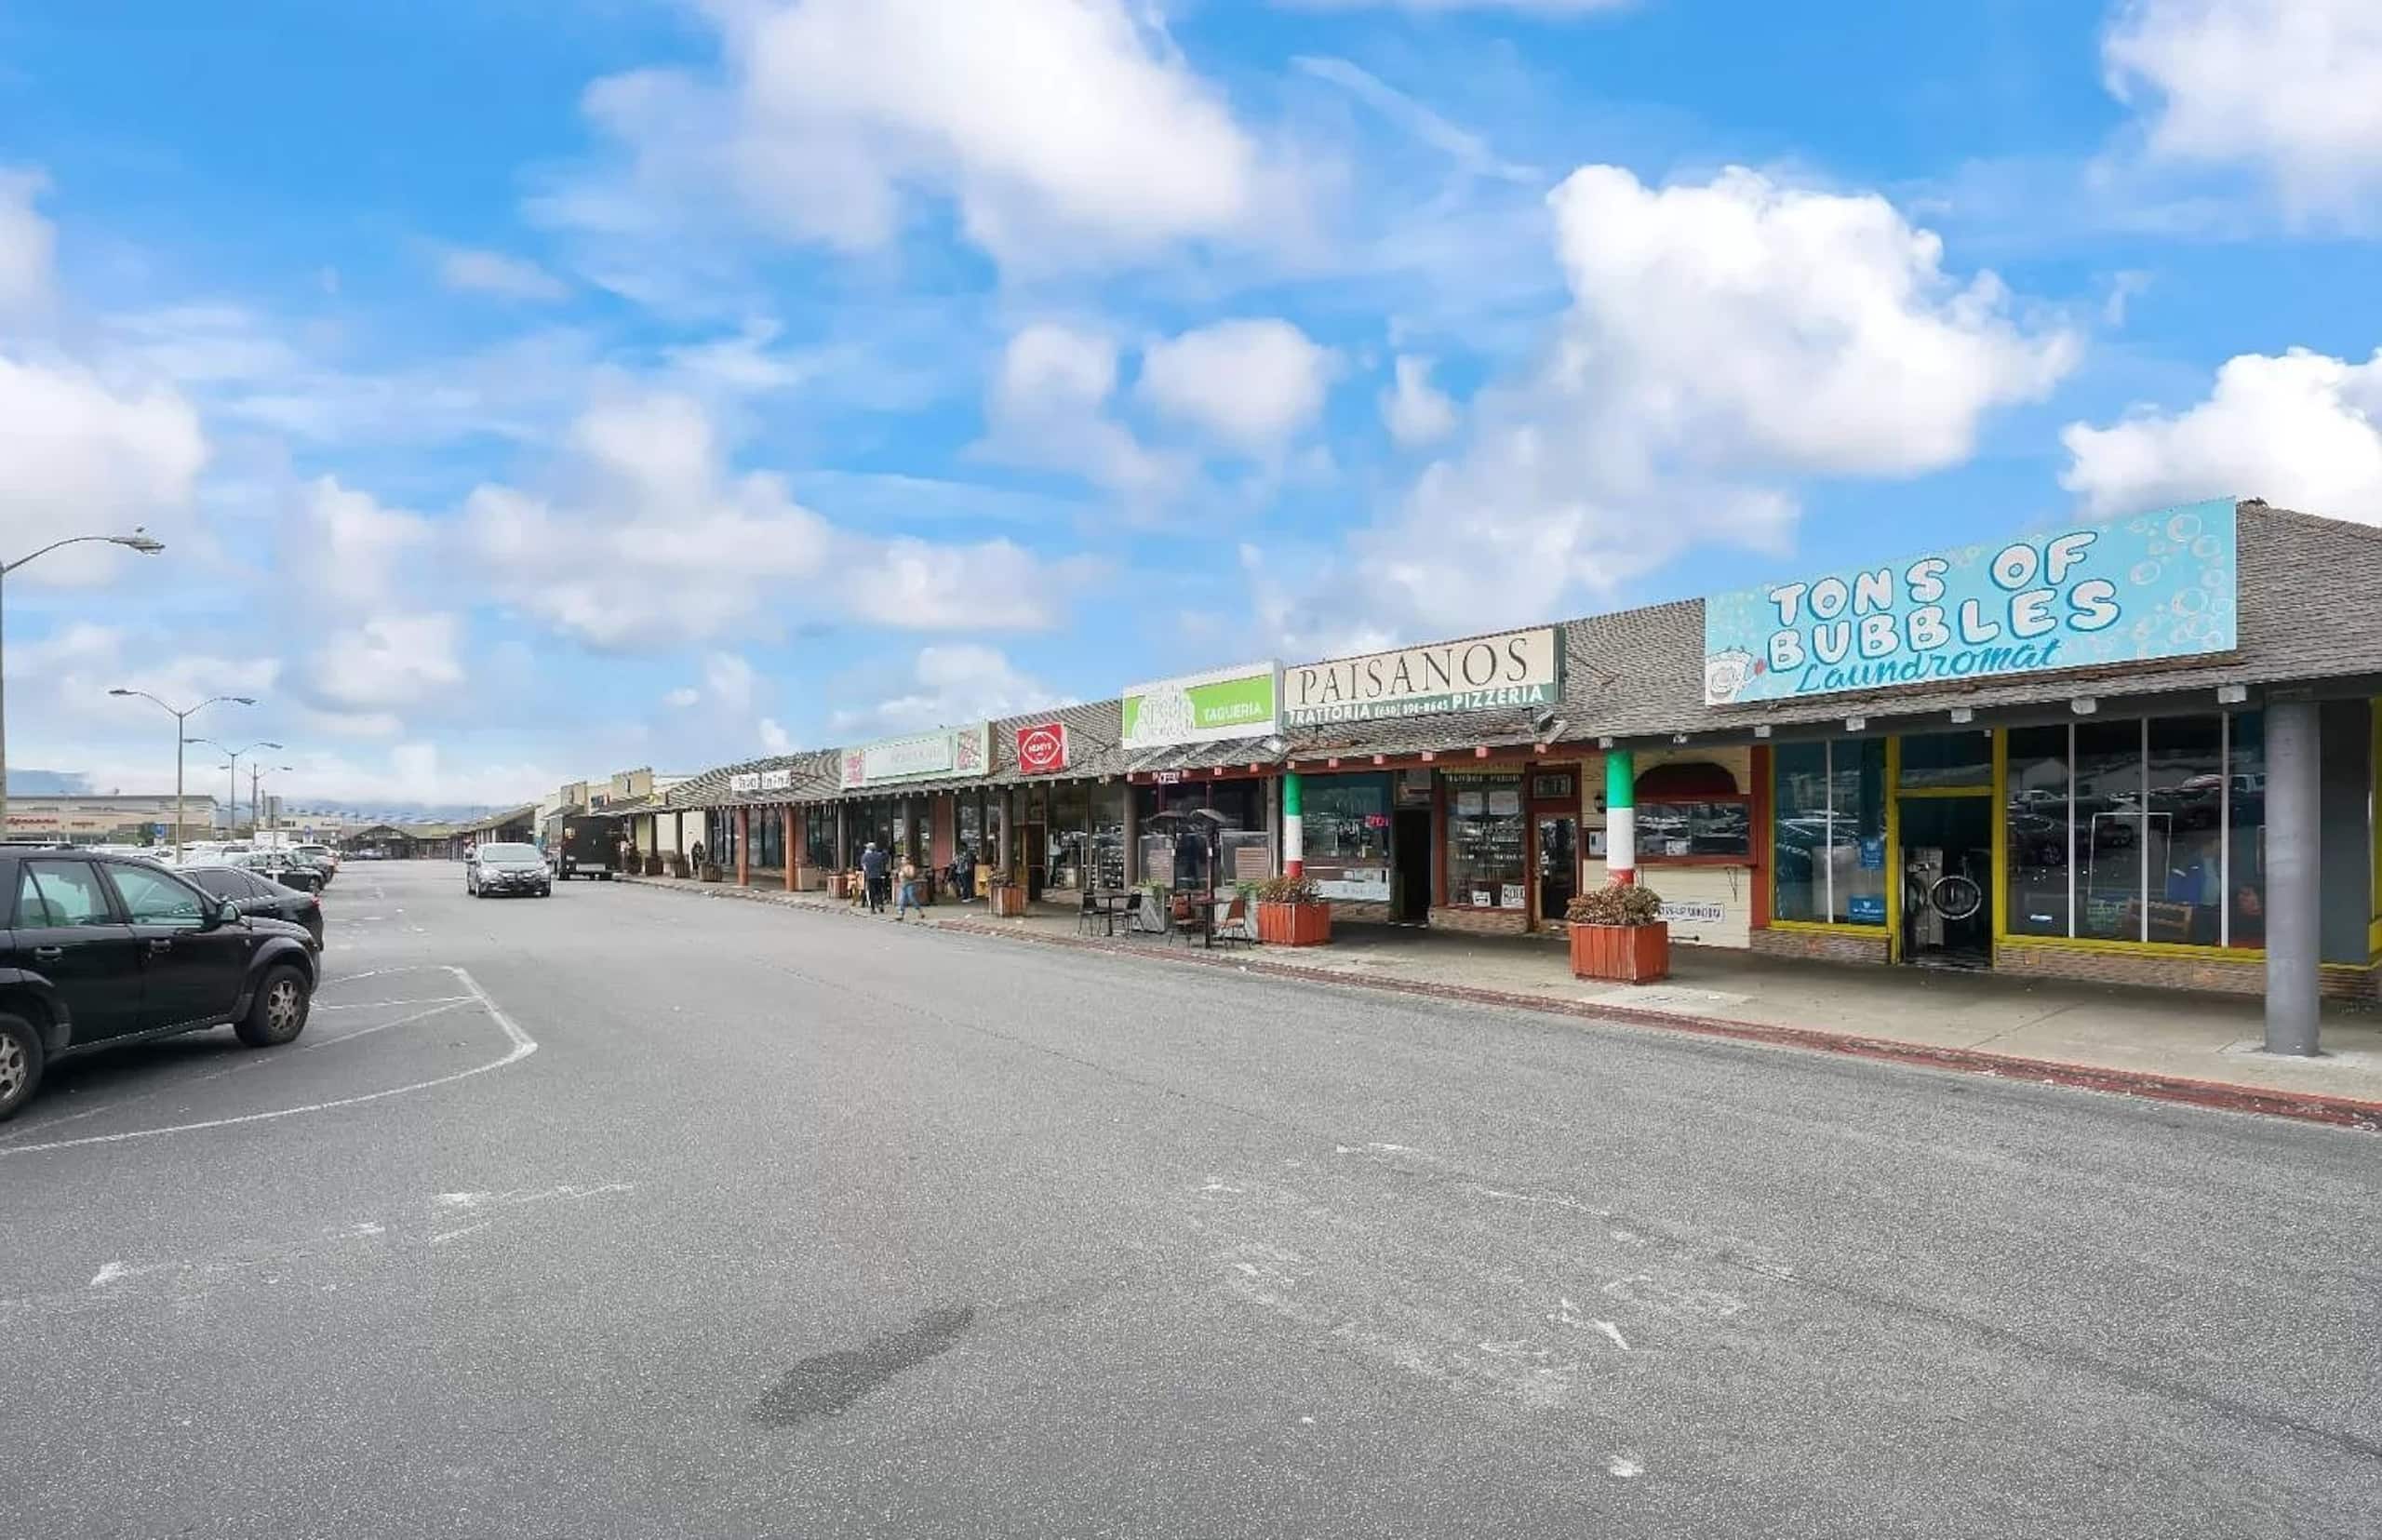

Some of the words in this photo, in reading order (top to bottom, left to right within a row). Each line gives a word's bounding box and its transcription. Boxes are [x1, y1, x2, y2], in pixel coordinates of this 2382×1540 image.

[1770, 557, 1949, 626] TONS
[1990, 531, 2099, 590] OF
[1768, 578, 2121, 673] BUBBLES
[1300, 637, 1527, 705] PAISANOS
[1795, 638, 2062, 693] Laundromat
[1289, 704, 1370, 725] TRATTORIA
[1452, 683, 1545, 709] PIZZERIA
